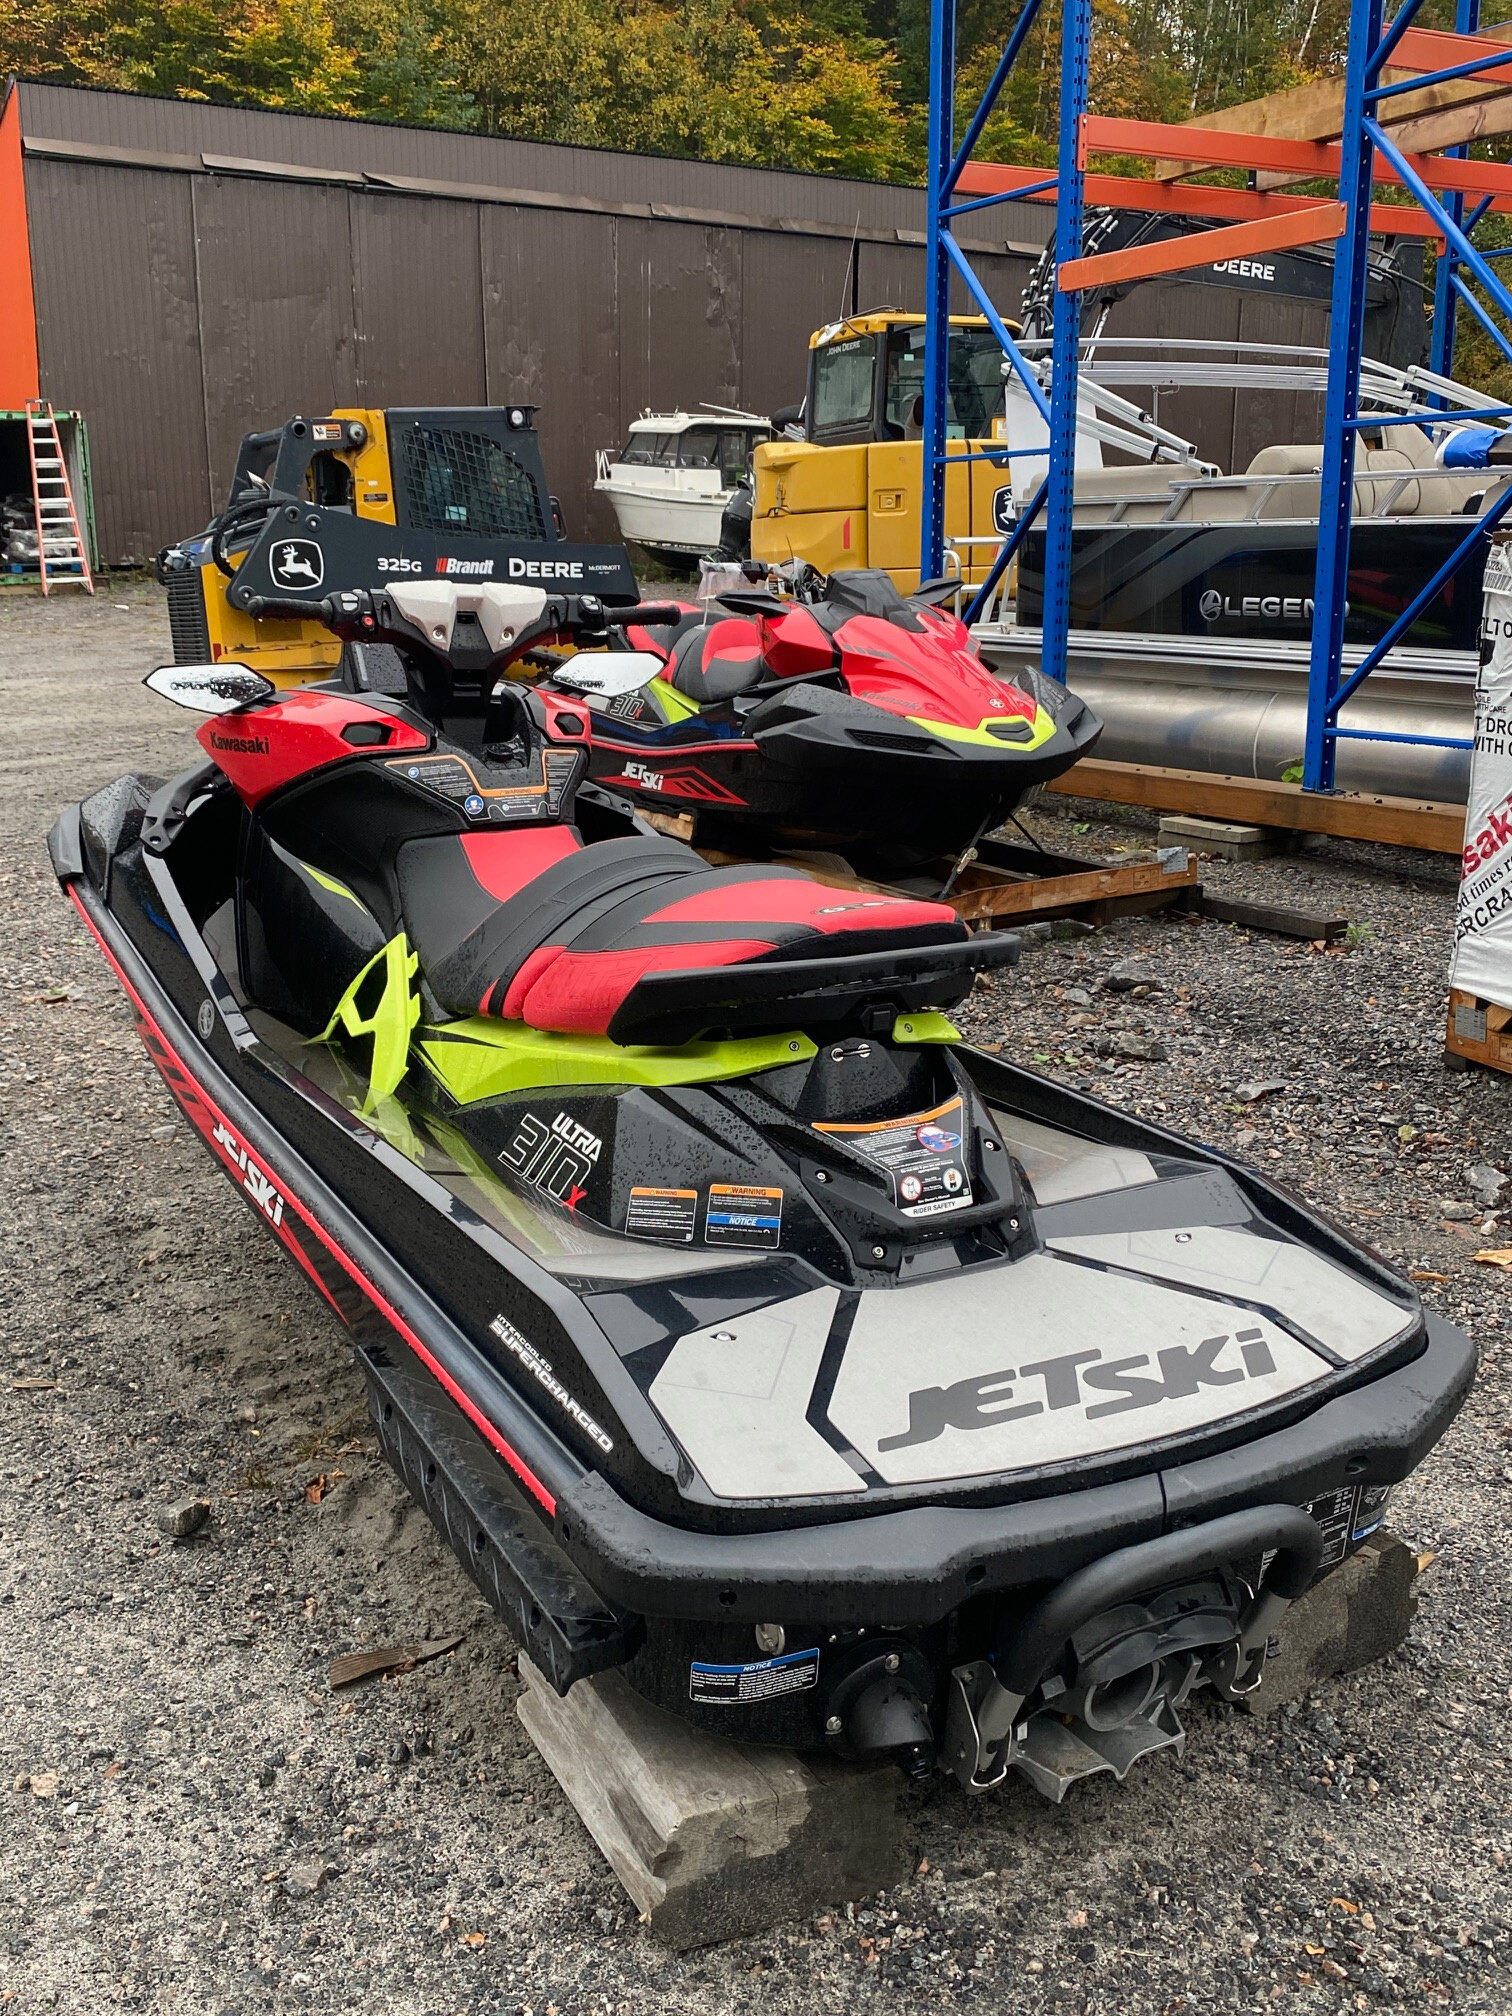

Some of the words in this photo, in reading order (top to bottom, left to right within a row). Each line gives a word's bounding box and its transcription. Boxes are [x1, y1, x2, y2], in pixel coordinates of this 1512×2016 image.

[1212, 259, 1276, 281] DEERE
[826, 346, 842, 357] JOHN
[842, 340, 861, 352] DEERE
[377, 557, 422, 573] 325G
[446, 557, 494, 575] Brandt
[508, 557, 584, 579] DEERE
[1224, 596, 1350, 619] LEGEN
[210, 731, 270, 755] Kawasaki
[1470, 866, 1505, 902] times
[884, 1117, 920, 1128] WARNING
[551, 1111, 603, 1162] ULTRA
[655, 1189, 678, 1197] WARNING
[731, 1187, 767, 1196] WARNING
[913, 1205, 932, 1214] RIDER
[933, 1201, 956, 1211] SAFETY
[729, 1216, 758, 1226] NOTICE
[496, 1313, 553, 1372] INTERCOOLED
[489, 1319, 614, 1454] SUPERCHARGED
[743, 1660, 772, 1672] NOTICE
